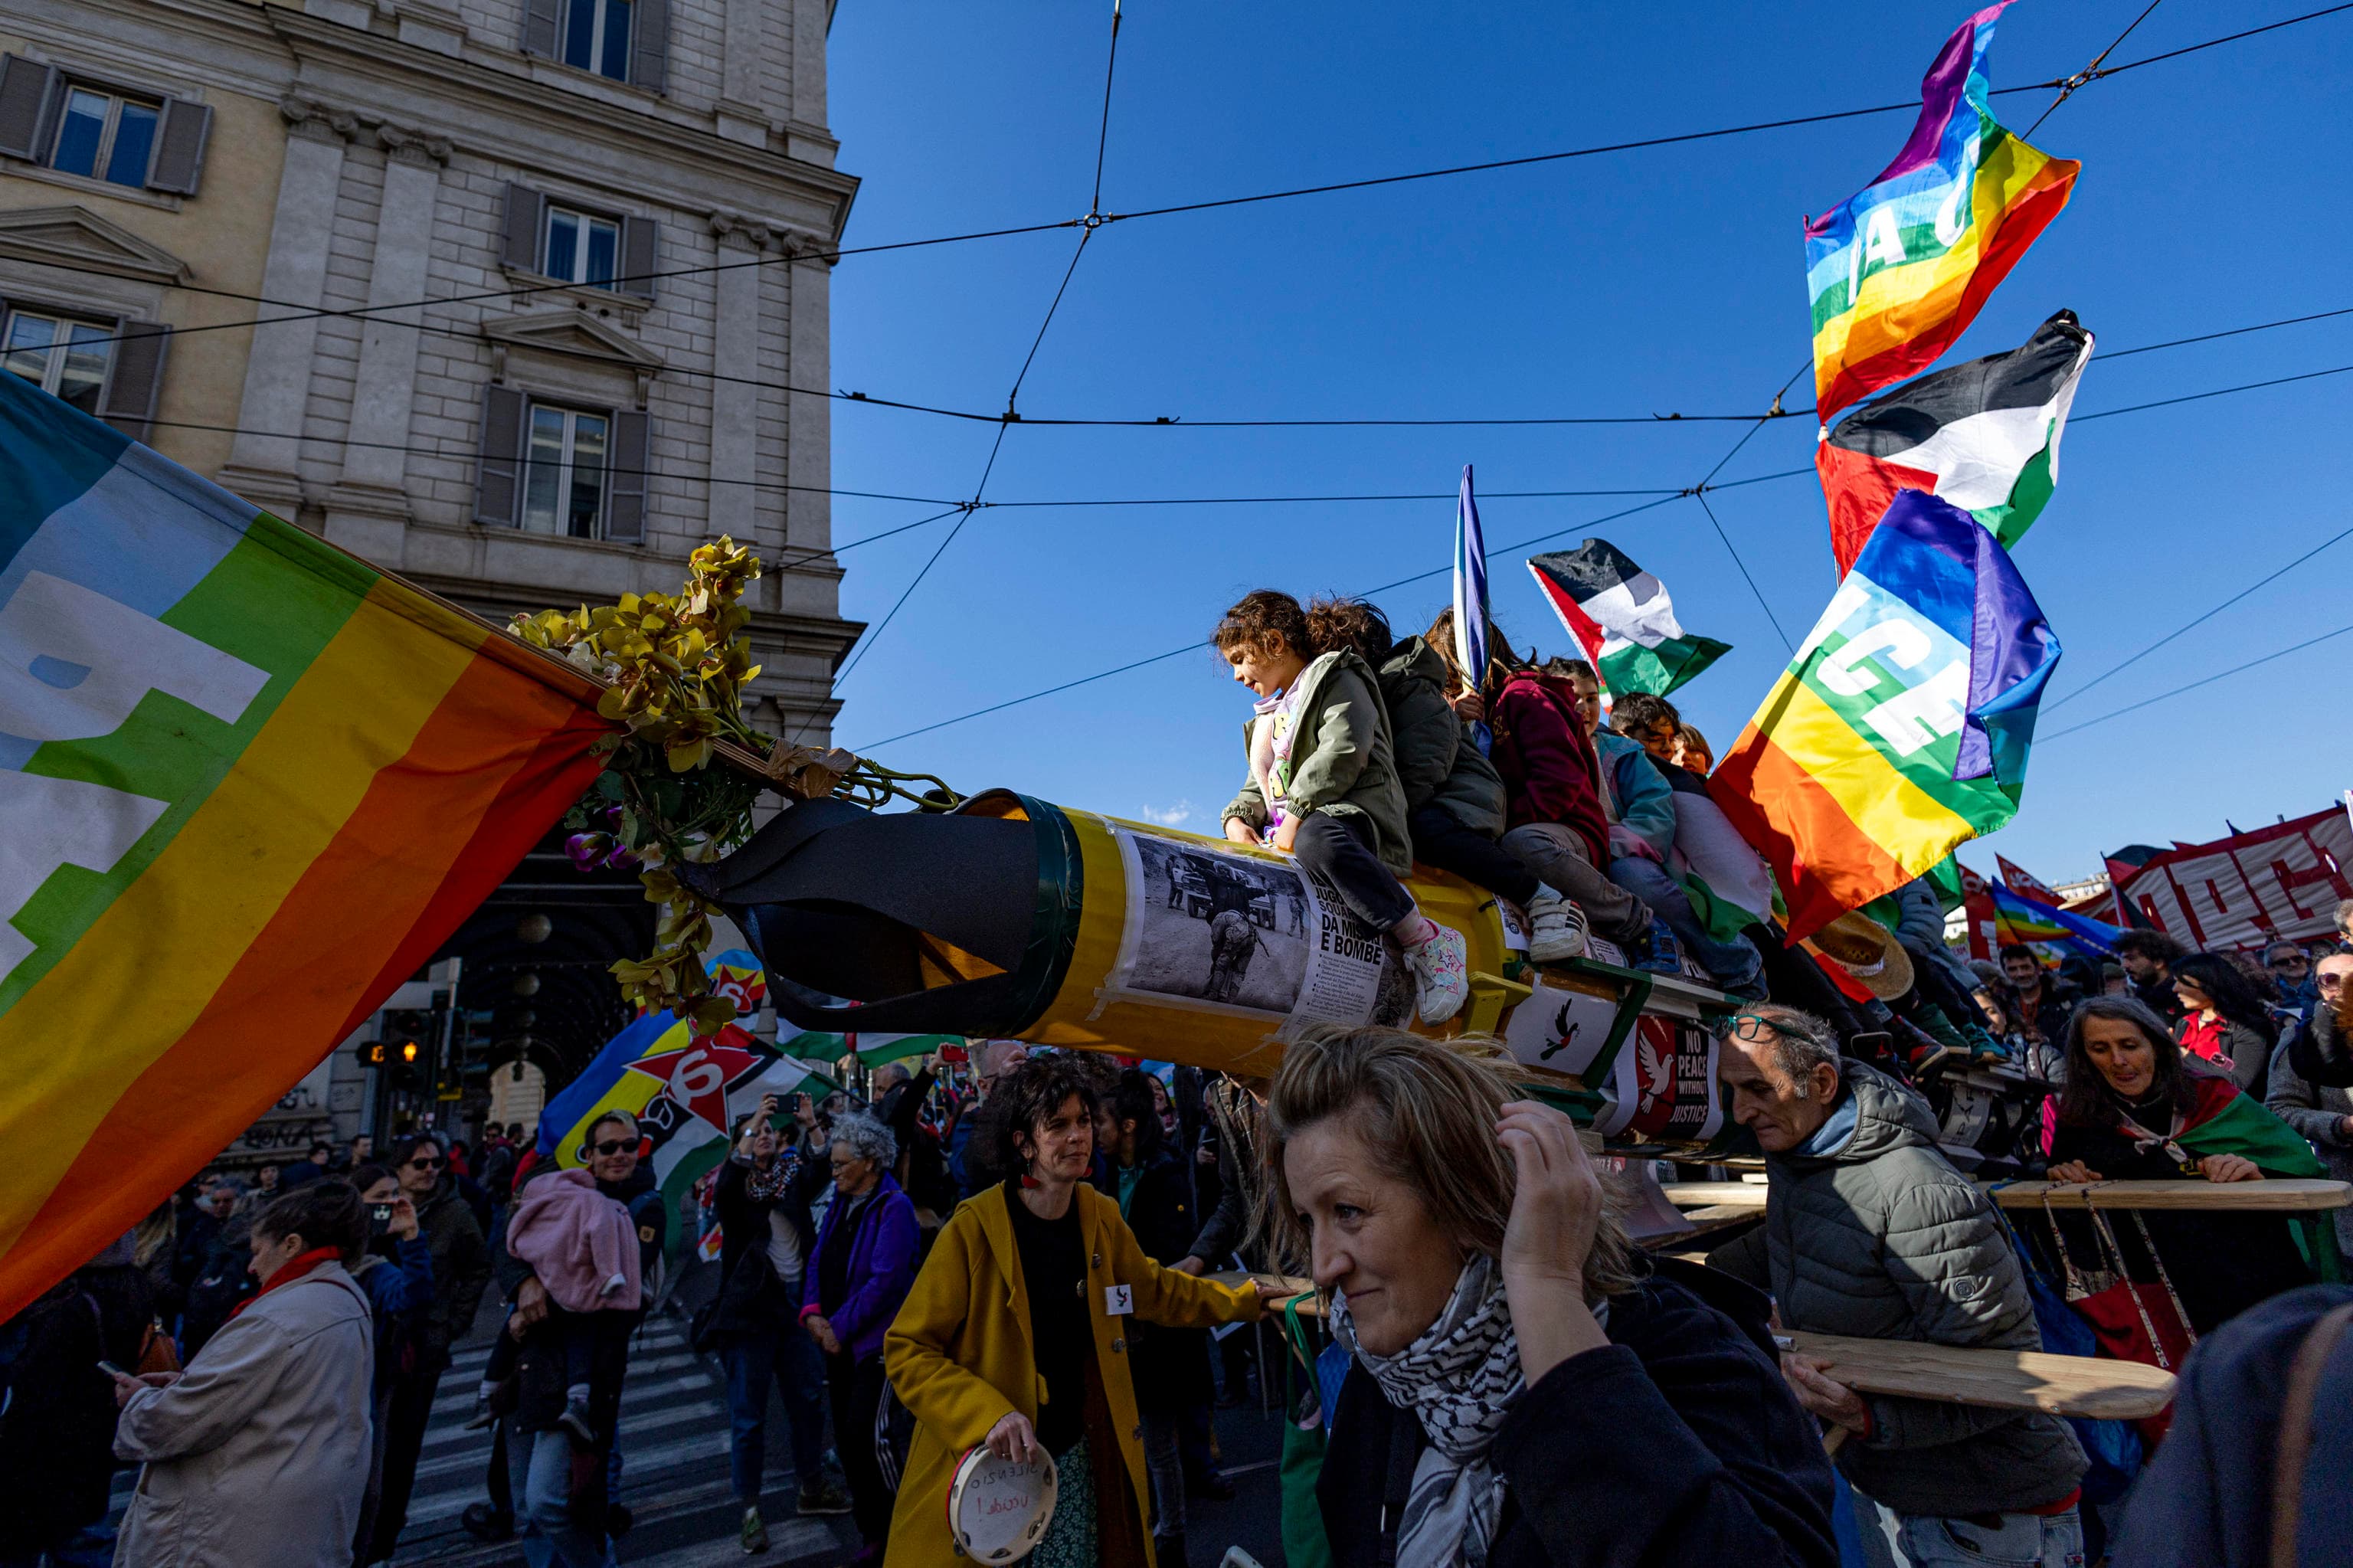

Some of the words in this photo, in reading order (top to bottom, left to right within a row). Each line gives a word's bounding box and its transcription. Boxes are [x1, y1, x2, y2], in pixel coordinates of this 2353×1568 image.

[1315, 887, 1346, 905] JUGO
[1318, 900, 1356, 921] SQUAR
[1322, 913, 1339, 934] DA
[1320, 931, 1330, 951] E
[1334, 935, 1383, 965] BOMBE
[1686, 1030, 1701, 1053] NO
[1678, 1055, 1707, 1078] PEACE
[1678, 1080, 1707, 1095] WITHOUT
[1669, 1105, 1708, 1123] JUSTICE
